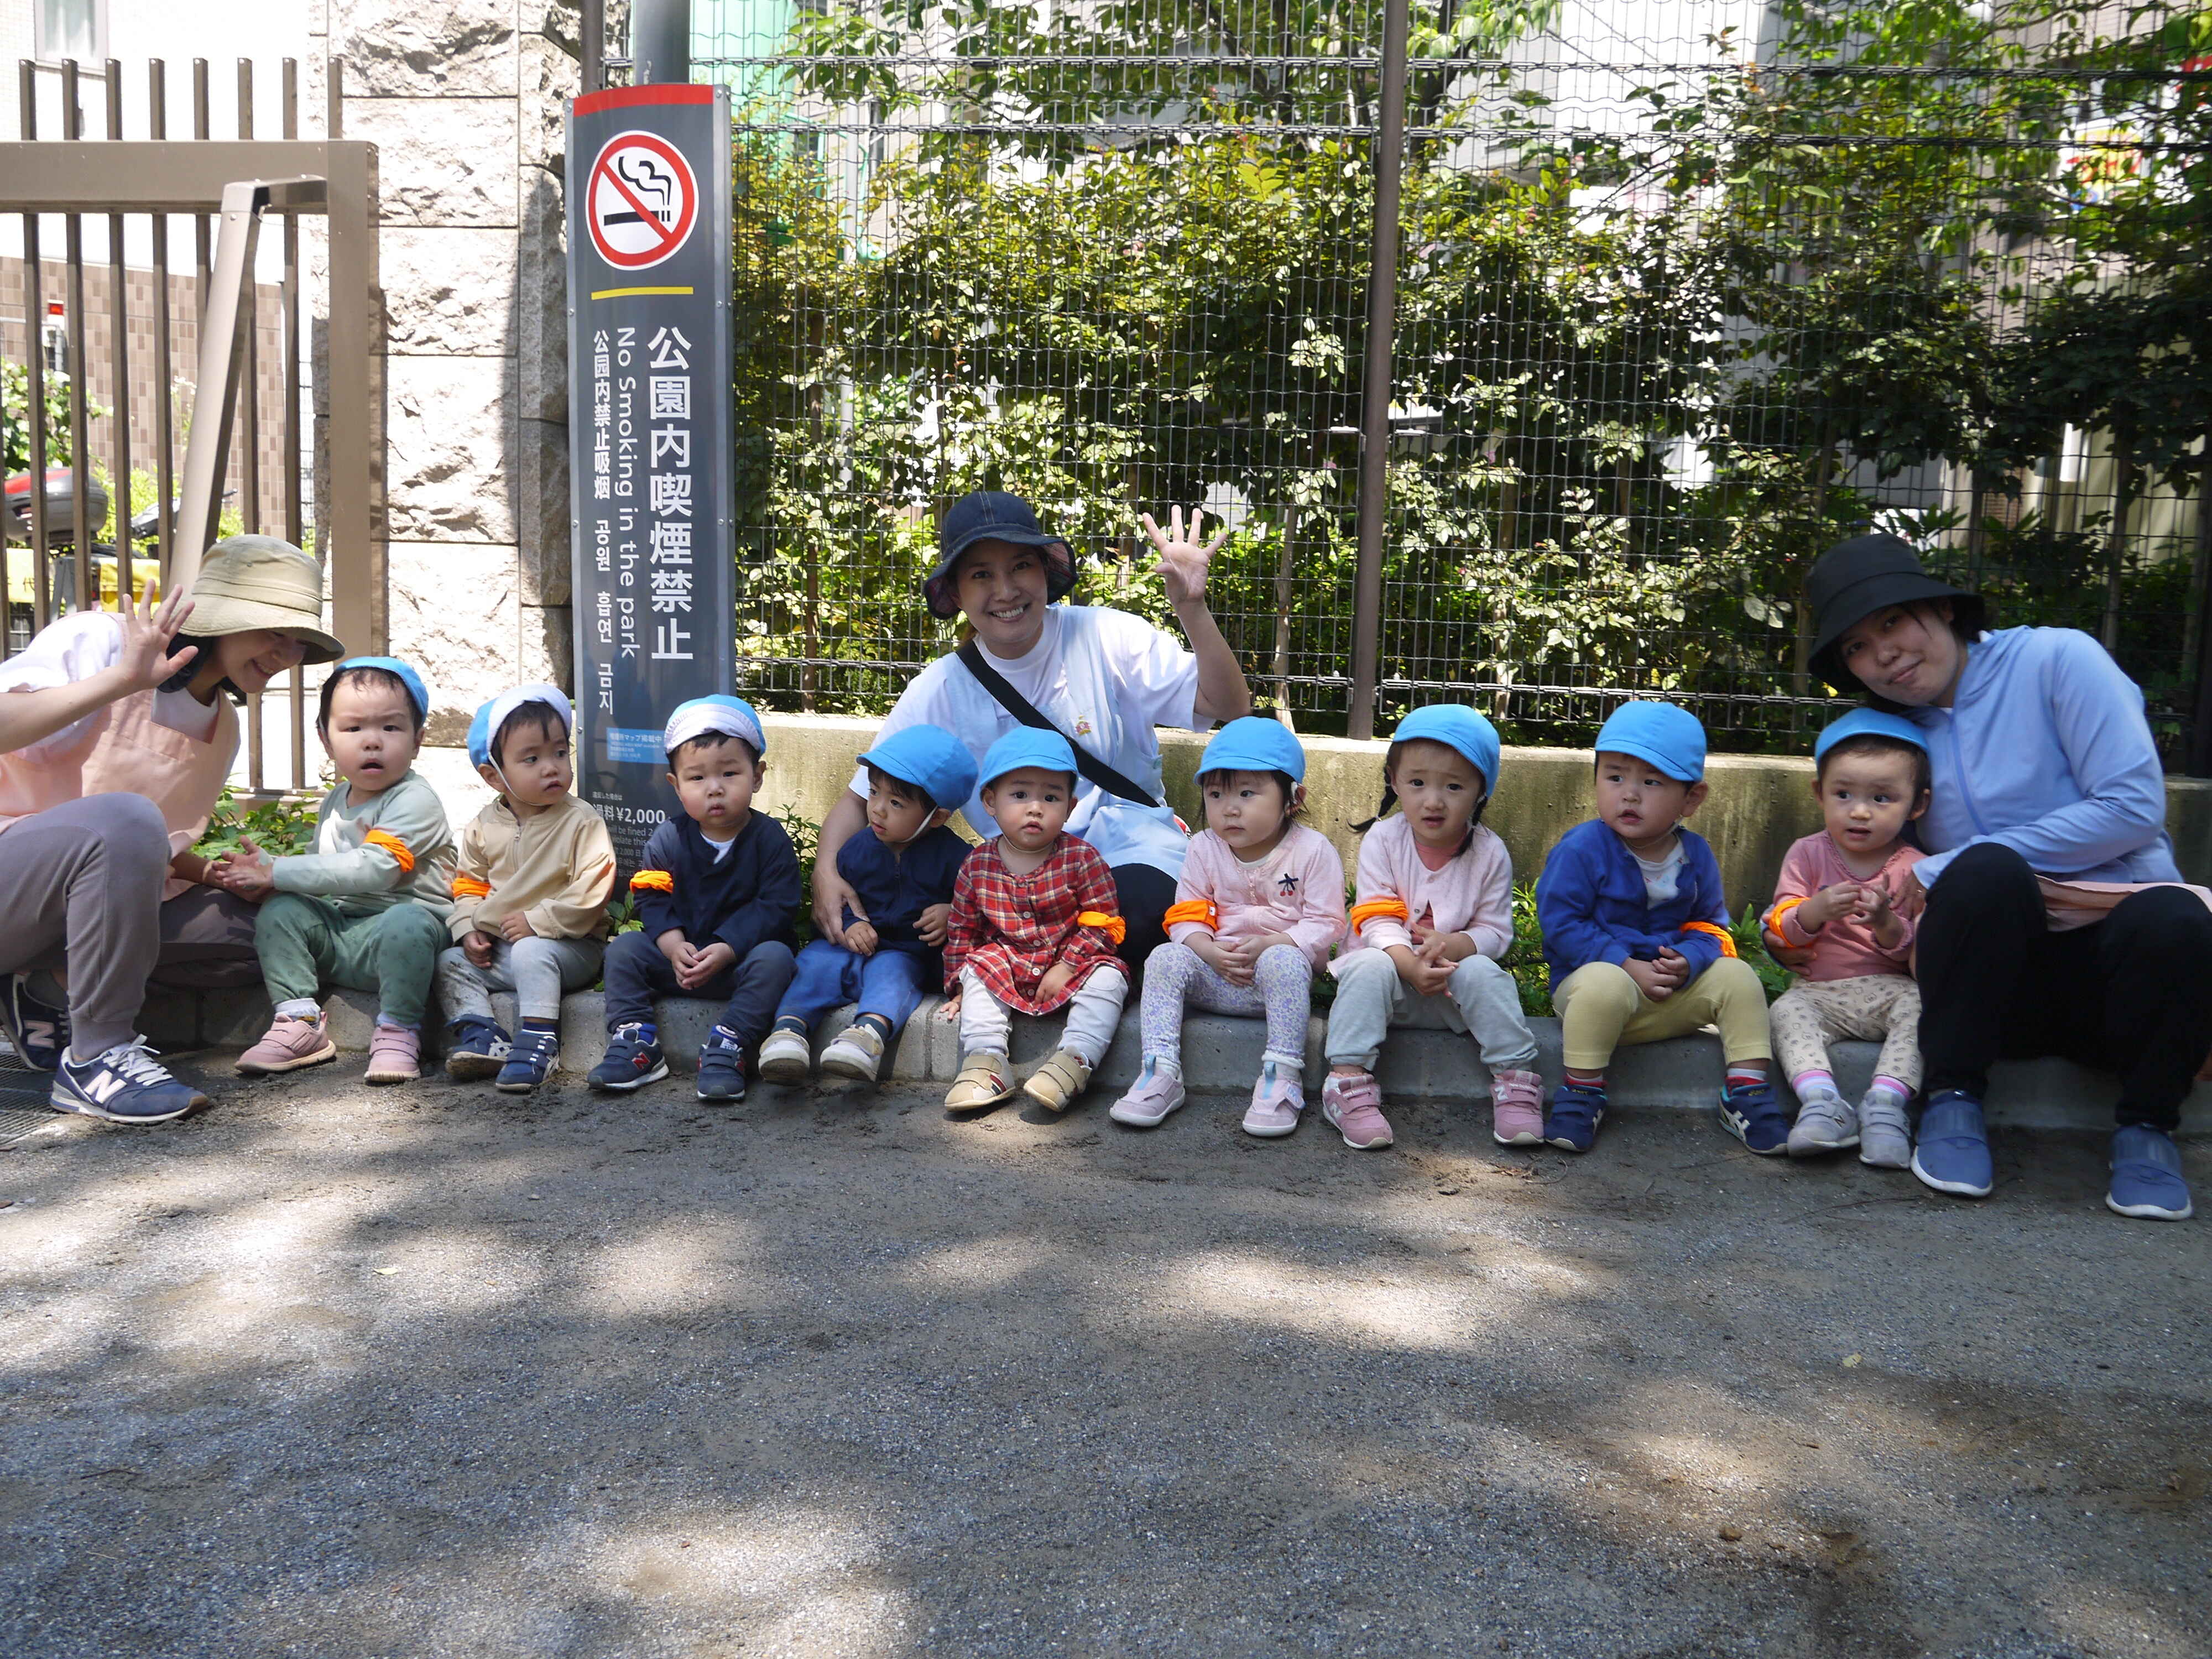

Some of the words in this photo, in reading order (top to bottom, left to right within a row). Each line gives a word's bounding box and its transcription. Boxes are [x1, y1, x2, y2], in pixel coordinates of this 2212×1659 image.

[617, 327, 636, 367] No
[593, 330, 612, 500] 公园内禁止吸烟
[615, 377, 638, 497] Smoking
[647, 326, 693, 660] 公園内喫煙禁止
[594, 520, 611, 571] 공원
[619, 508, 639, 531] in
[619, 540, 640, 587] the
[597, 591, 612, 643] 흡연
[616, 598, 640, 658] park
[598, 663, 614, 715] 금지
[84, 1070, 127, 1104] N
